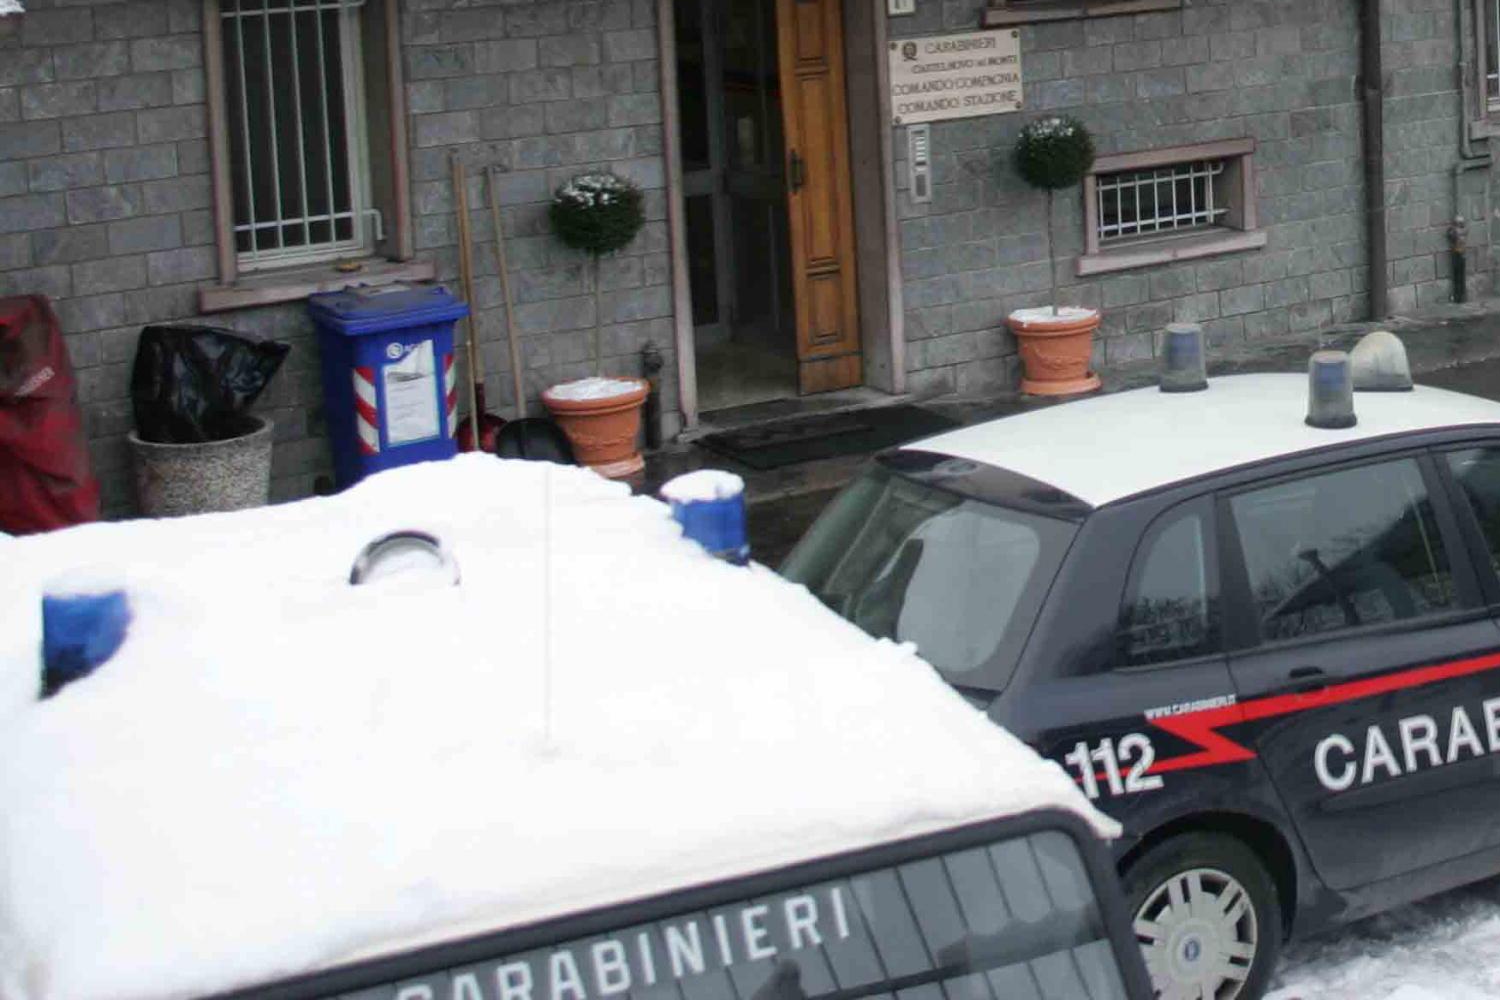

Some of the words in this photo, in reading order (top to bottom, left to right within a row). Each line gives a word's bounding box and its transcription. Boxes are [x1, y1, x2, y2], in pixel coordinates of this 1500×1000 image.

[925, 37, 995, 53] CARABINIERI
[894, 81, 953, 95] COMANDO
[898, 99, 958, 114] COMANDO
[964, 90, 1017, 106] STAZIONE
[1065, 733, 1165, 799] 112
